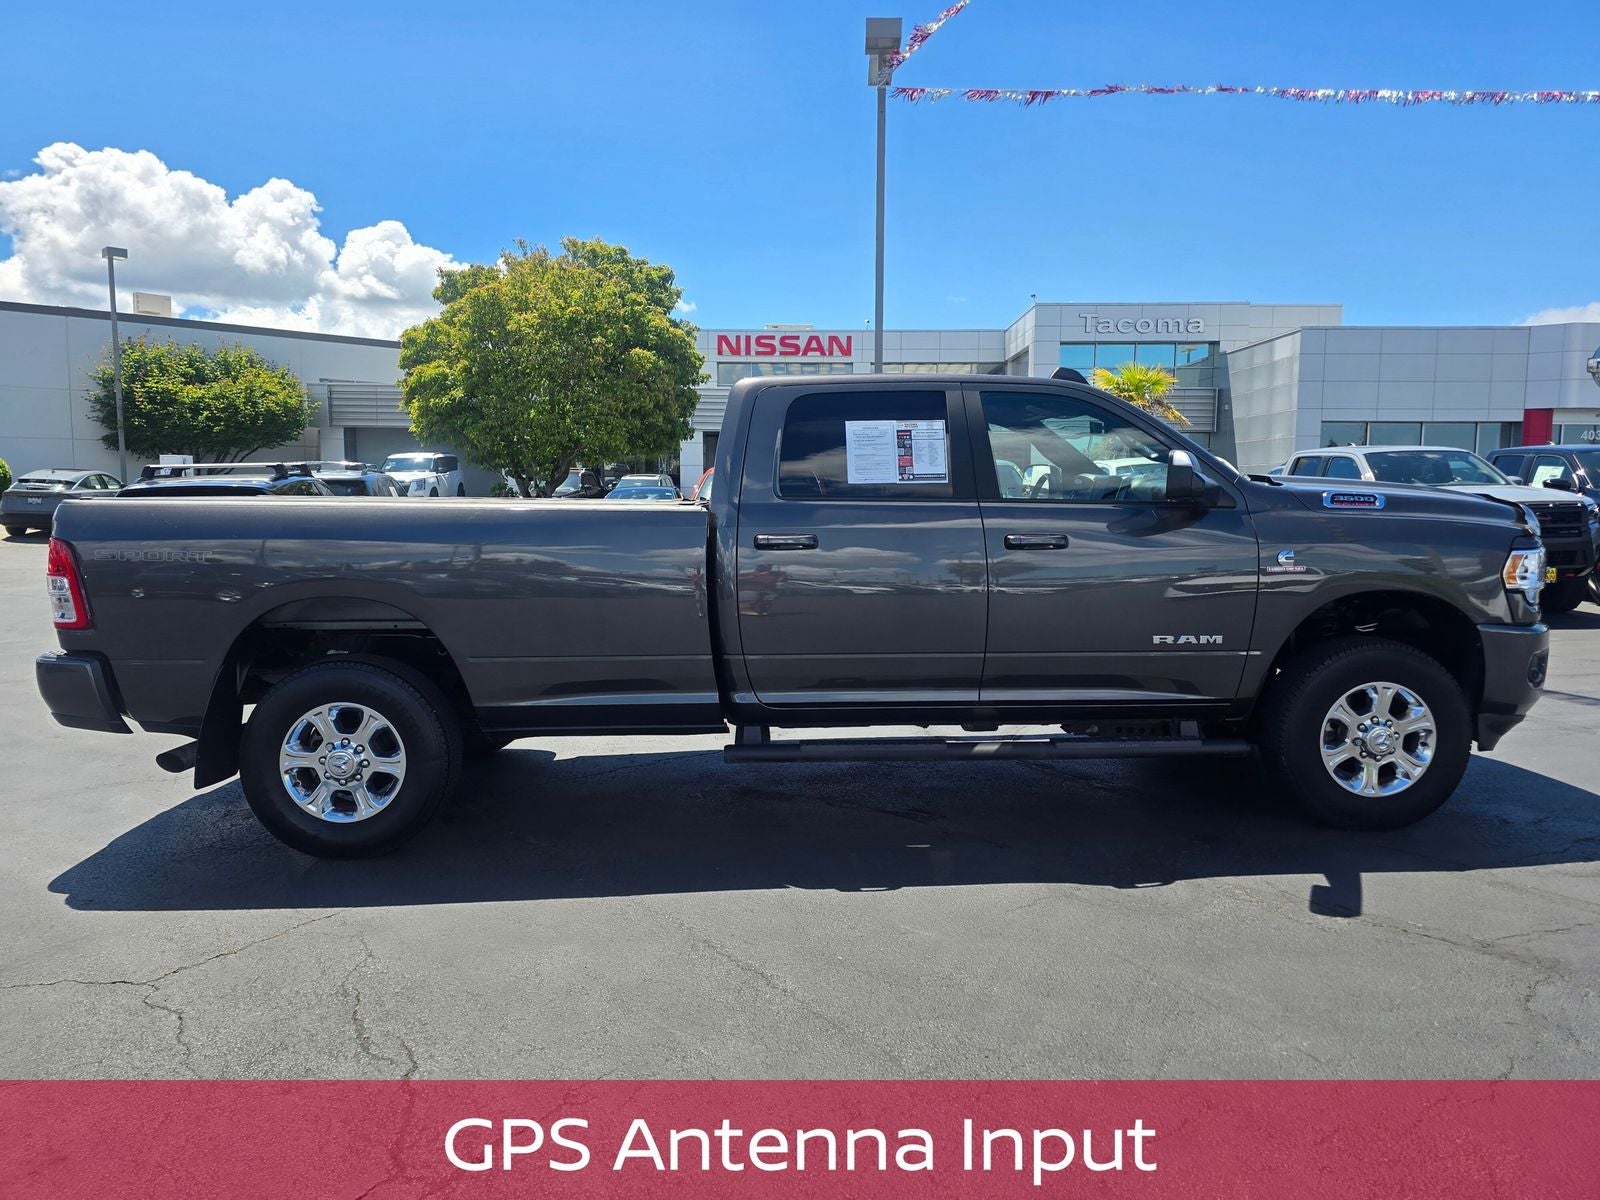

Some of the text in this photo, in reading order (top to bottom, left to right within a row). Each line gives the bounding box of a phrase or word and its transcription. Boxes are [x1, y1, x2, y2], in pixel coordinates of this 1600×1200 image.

[1079, 313, 1205, 334] Tacoma
[717, 335, 852, 356] NISSAN
[95, 549, 212, 561] SPORT
[1152, 635, 1223, 644] RAM
